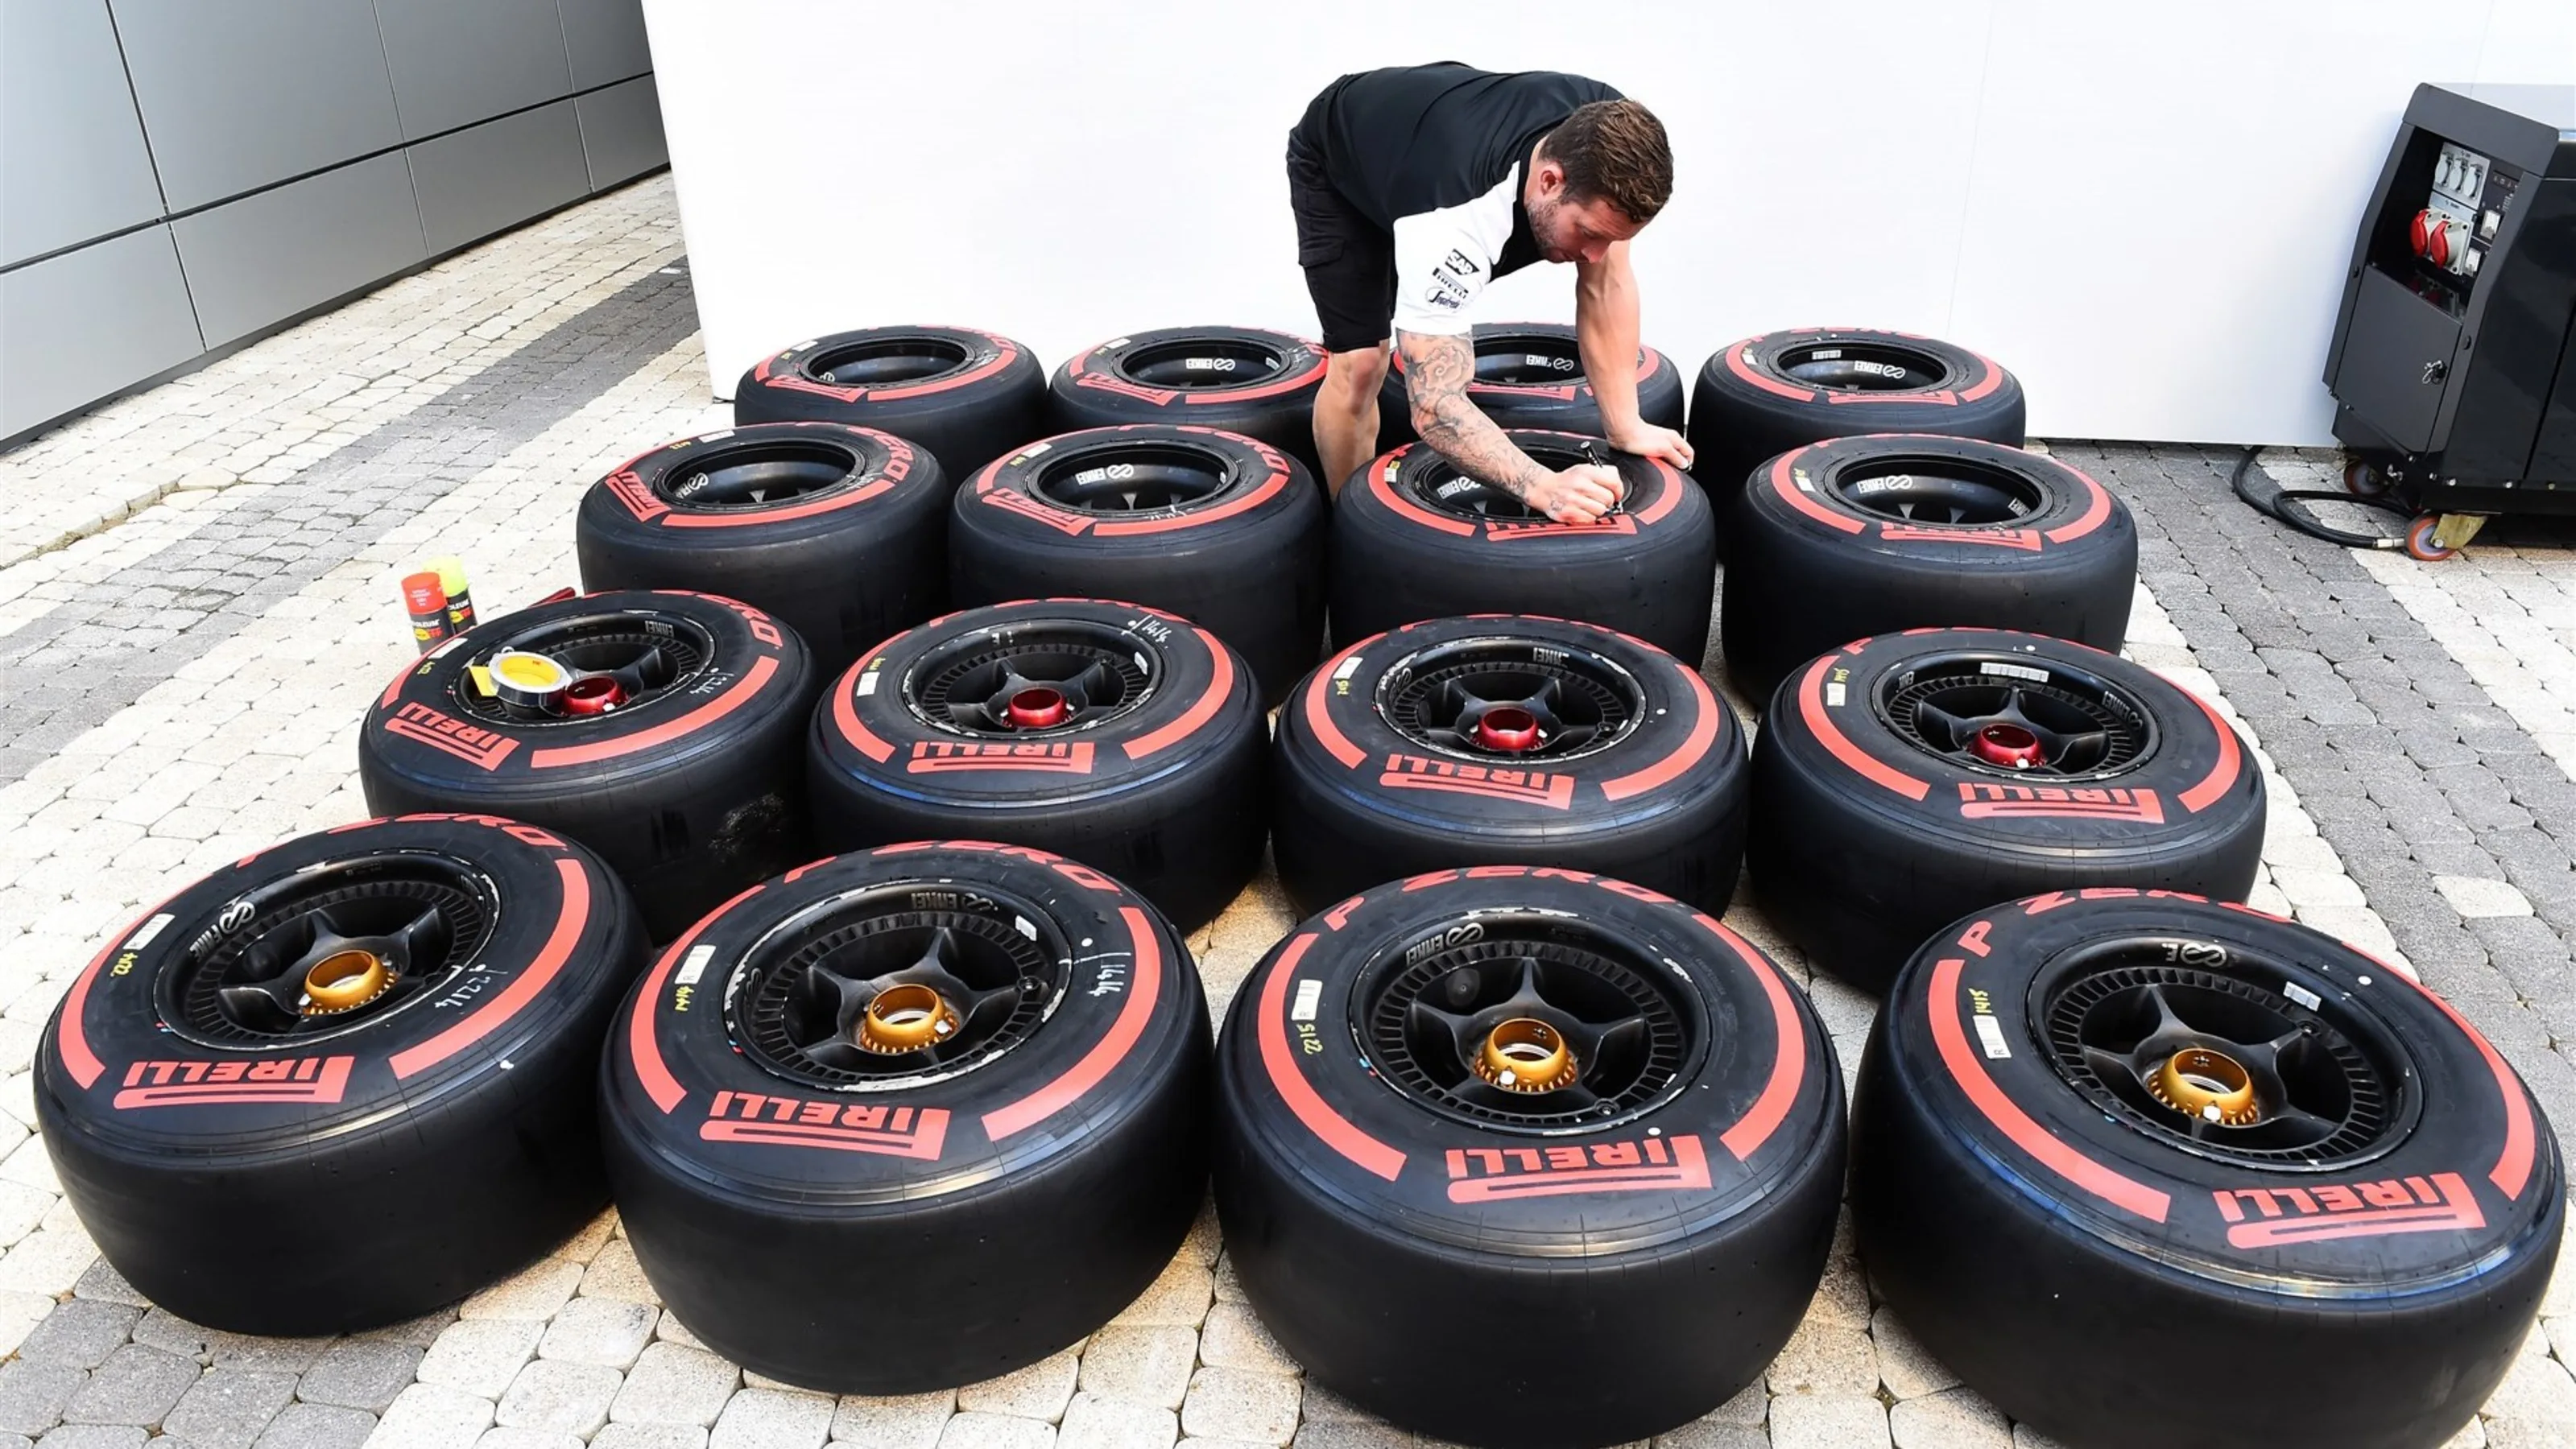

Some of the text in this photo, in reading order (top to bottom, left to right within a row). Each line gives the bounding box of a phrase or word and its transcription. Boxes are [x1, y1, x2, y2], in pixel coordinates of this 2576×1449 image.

[1445, 249, 1479, 275] SAP
[385, 701, 520, 771] PIRELLI
[907, 741, 1095, 774] PIRELLI
[1379, 753, 1576, 810] PIRELLI
[1958, 782, 2165, 824] PIRELLI
[911, 891, 960, 910] ENKEI
[1325, 897, 1365, 931] P
[1405, 933, 1445, 965] ENKEI
[1958, 921, 1993, 957] P
[114, 1055, 354, 1109] PIRELLI
[700, 1091, 950, 1160] PIRELLI
[1445, 1134, 1712, 1203] PIRELLI
[2213, 1173, 2486, 1249] PIRELLI
